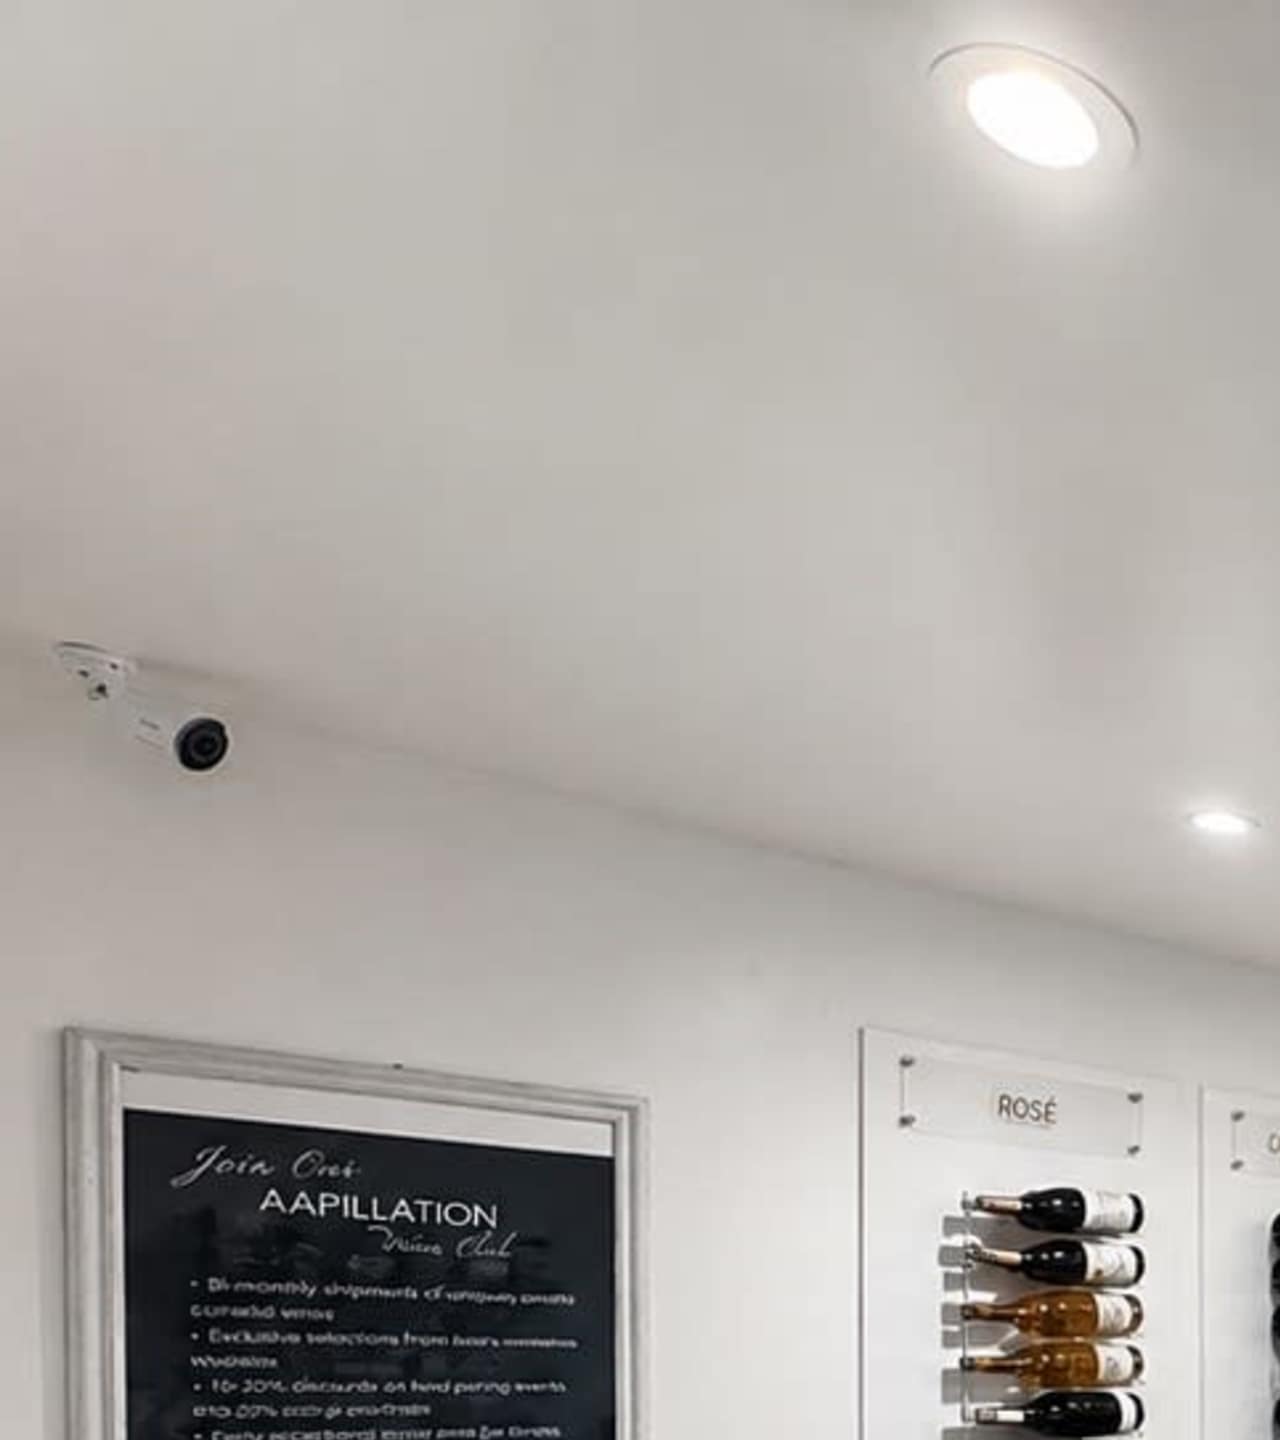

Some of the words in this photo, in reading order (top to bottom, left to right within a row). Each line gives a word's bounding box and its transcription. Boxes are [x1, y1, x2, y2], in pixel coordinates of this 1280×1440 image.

[998, 1093, 1057, 1124] ROSÉ
[170, 1145, 275, 1187] Join
[259, 1188, 497, 1229] AAPILLATION
[455, 1231, 517, 1258] Club
